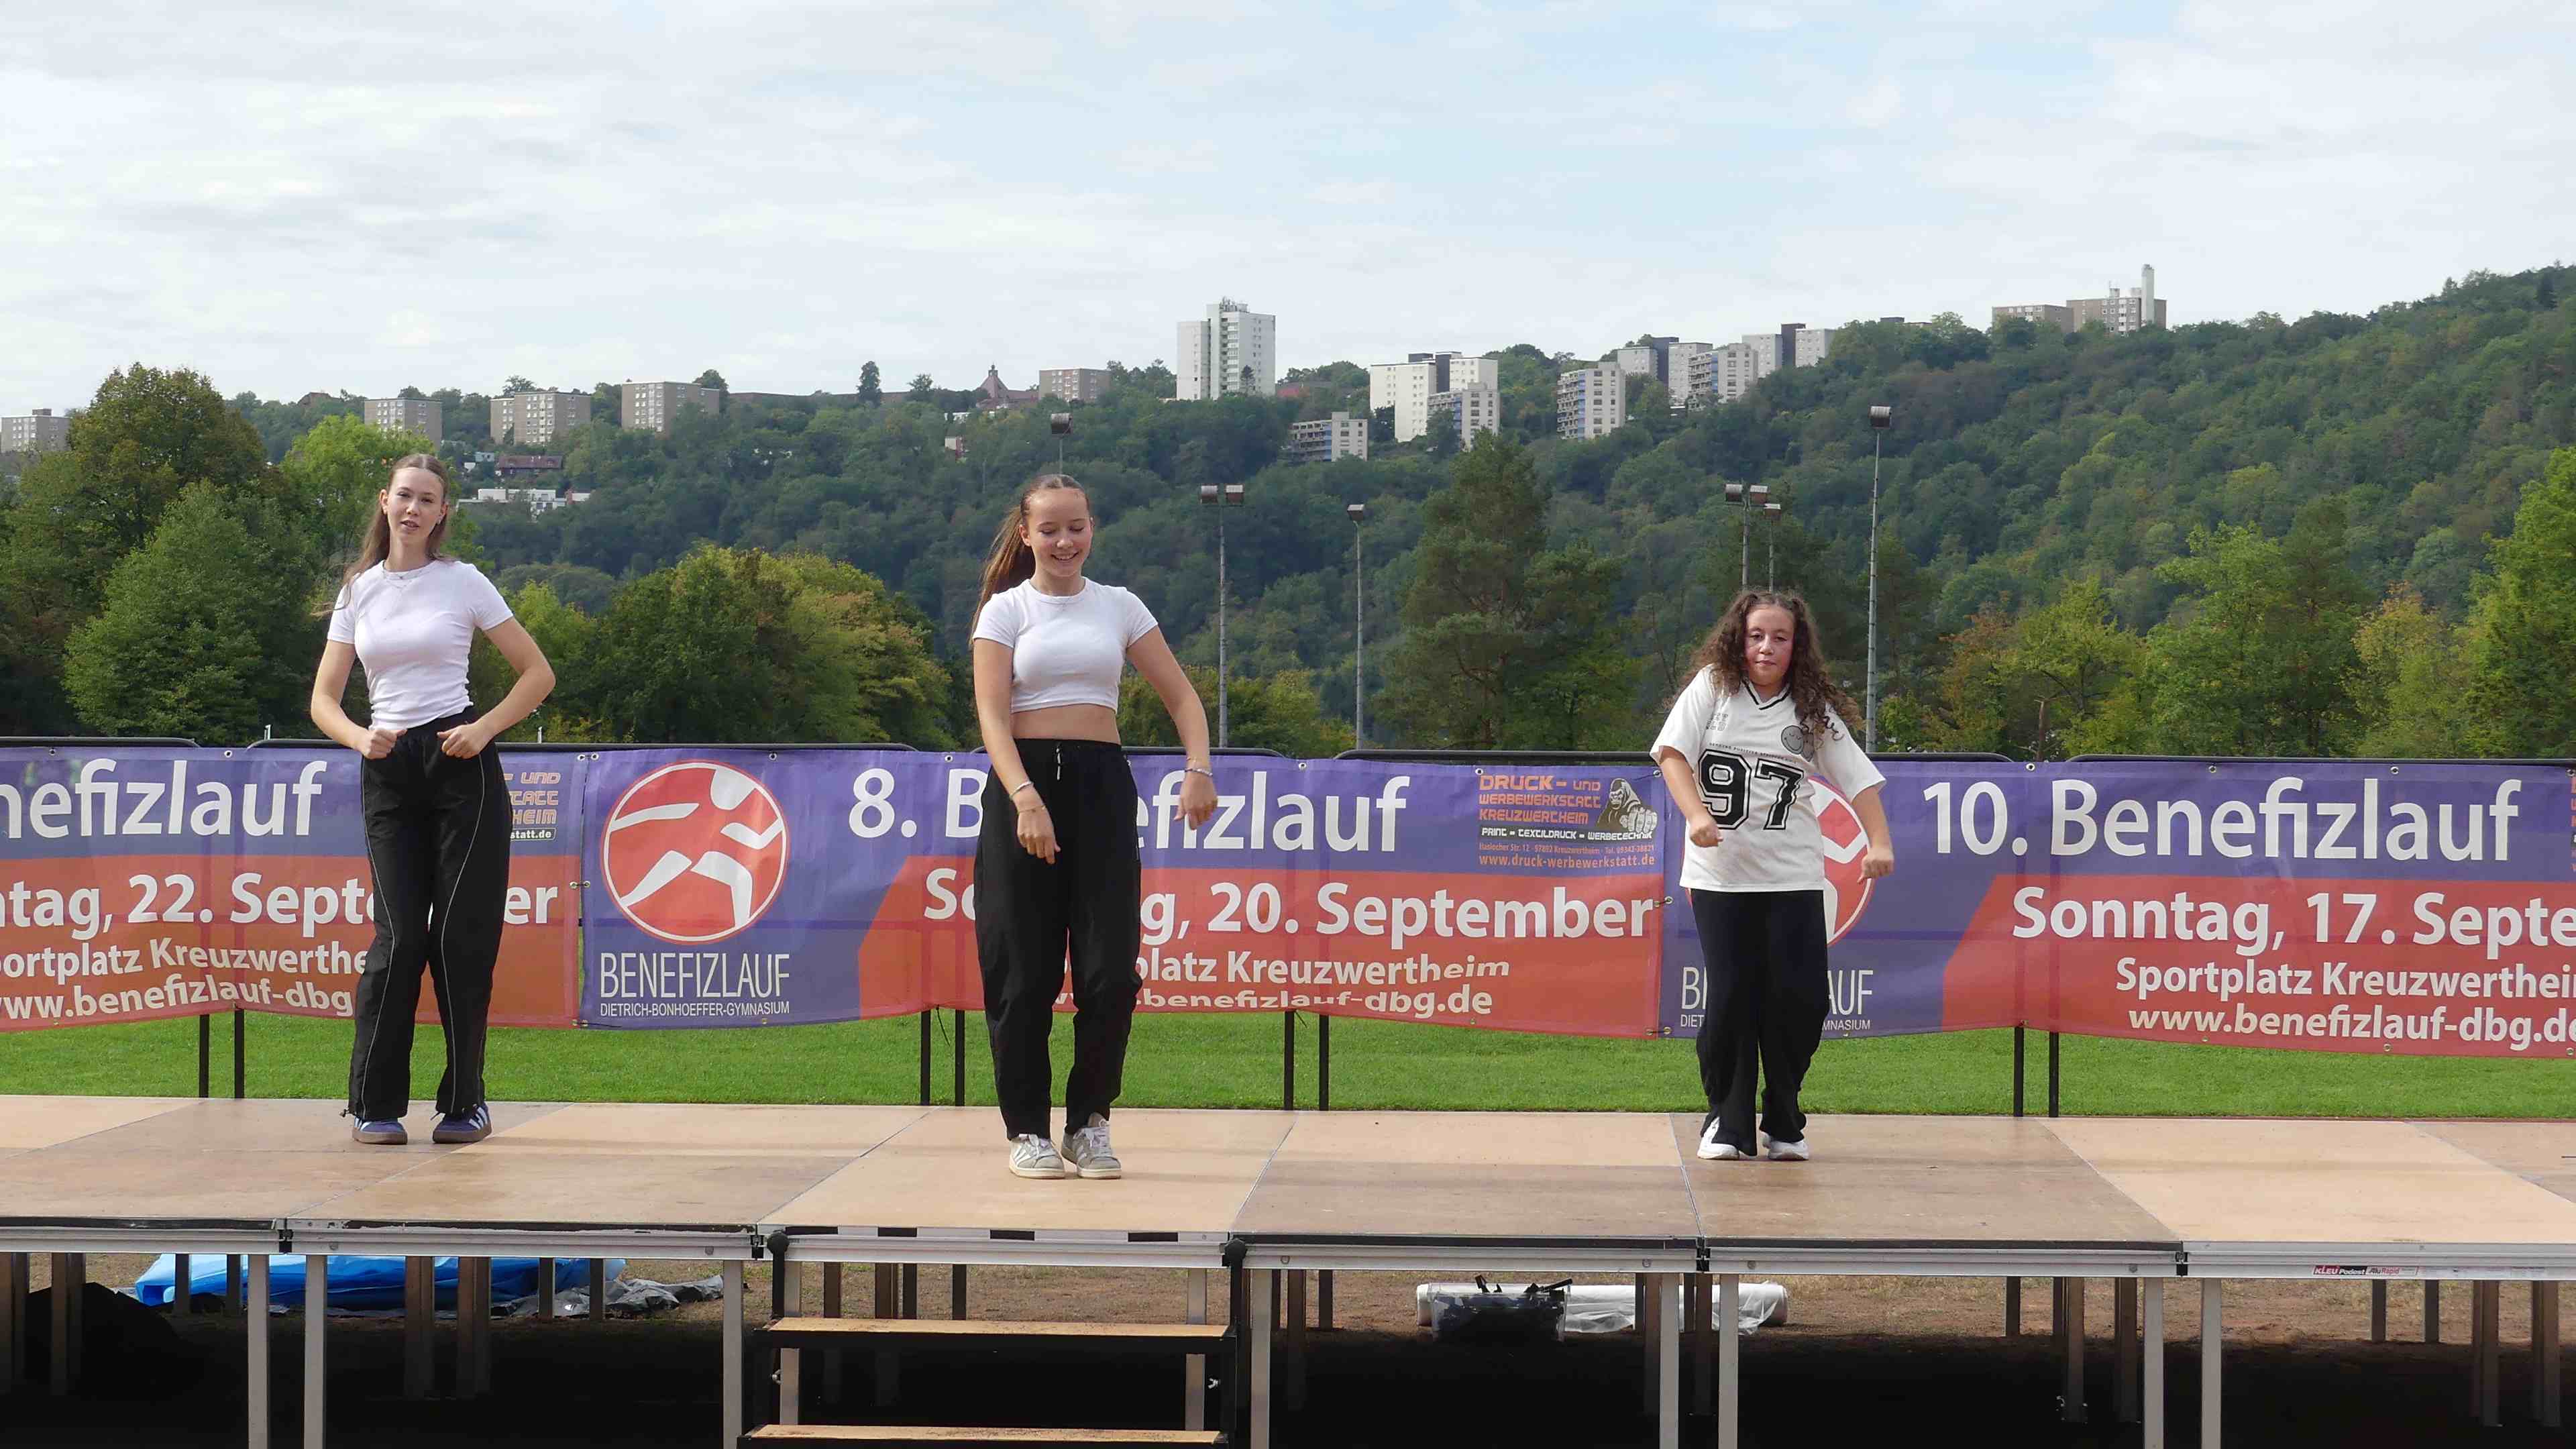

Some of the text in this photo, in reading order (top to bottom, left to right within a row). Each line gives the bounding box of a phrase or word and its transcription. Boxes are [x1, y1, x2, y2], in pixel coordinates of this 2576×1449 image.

[849, 768, 1410, 852] 8. Bfzlauf
[1479, 794, 1601, 808] WERBEWERKSTATT
[1698, 749, 1805, 830] 97
[1479, 808, 1589, 825] KREUZWERTHEIM
[1481, 827, 1507, 837] PRINT
[1517, 829, 1576, 840] TEXTILDRUCK
[1587, 831, 1653, 841] WERBETECHNIK
[1923, 781, 2028, 856] 10.
[2051, 777, 2522, 861] Benefizlauf
[1479, 852, 1655, 869] www.druck-werbewerkstatt.de
[127, 873, 213, 923] 22.
[230, 873, 558, 938] Septer
[1208, 882, 1299, 934] 20.
[1316, 882, 1654, 950] September
[2012, 886, 2285, 956] Sonntag,
[2306, 893, 2396, 945] 17.
[0, 937, 366, 985] ortplatz Kreuzwerthe
[600, 953, 790, 998] BENEFIZLAUF
[1226, 951, 1510, 985] Kreuzwertheim
[2116, 957, 2576, 1002] Sportplatz Kreuzwerthei
[600, 1000, 790, 1017] DIETRICH-BONHOEFFER-GYMNASIUM
